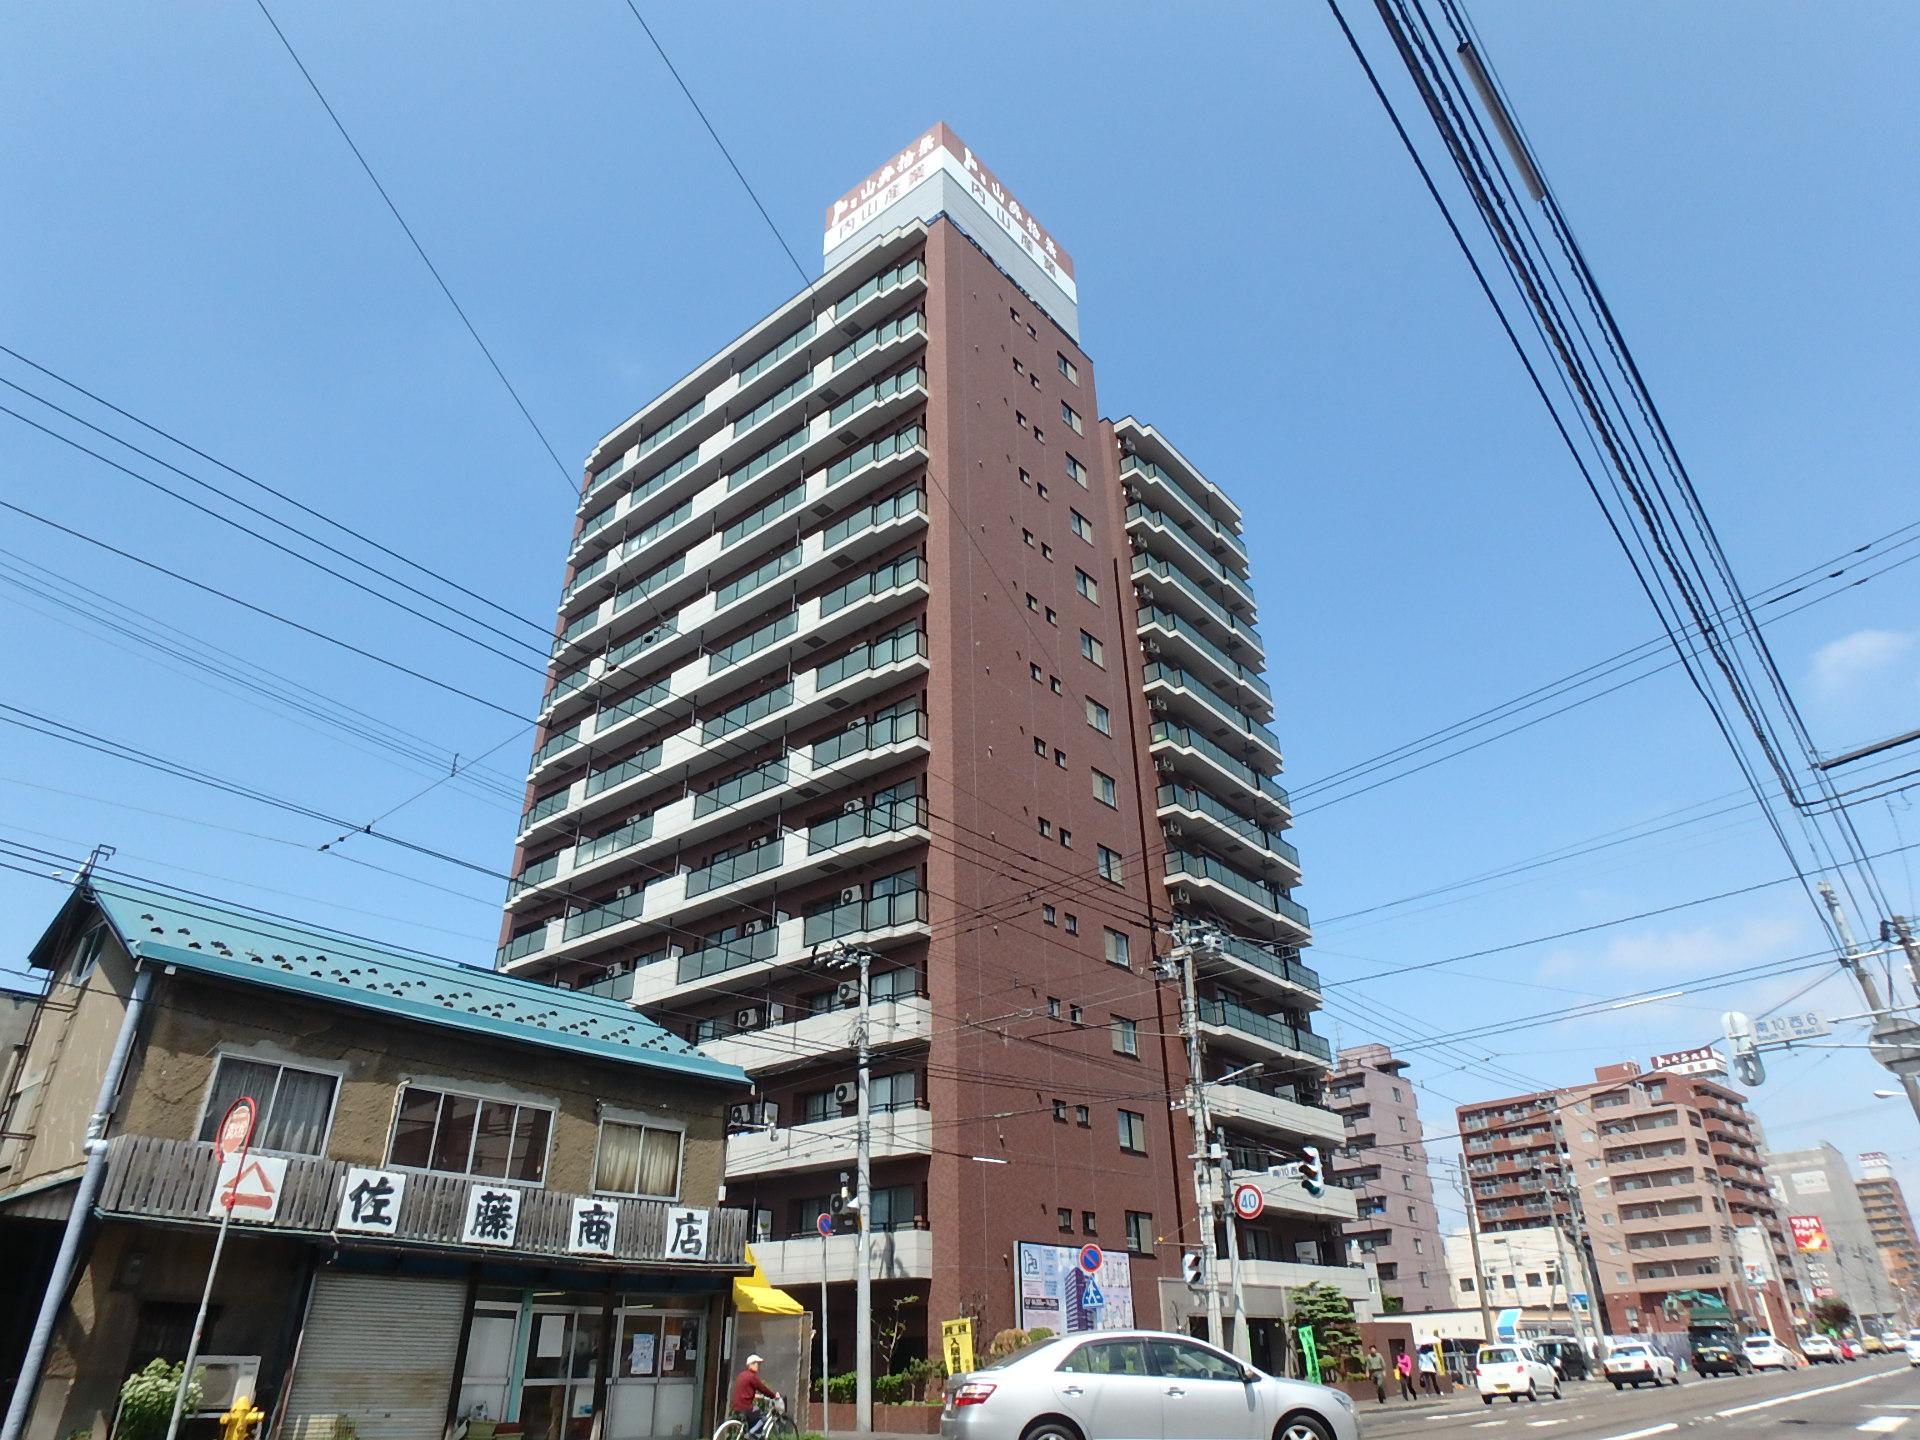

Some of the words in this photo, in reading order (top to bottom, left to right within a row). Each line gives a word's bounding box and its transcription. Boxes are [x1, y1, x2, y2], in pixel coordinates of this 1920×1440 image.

[349, 1176, 703, 1255] 佐藤商店
[1240, 1193, 1257, 1209] 40
